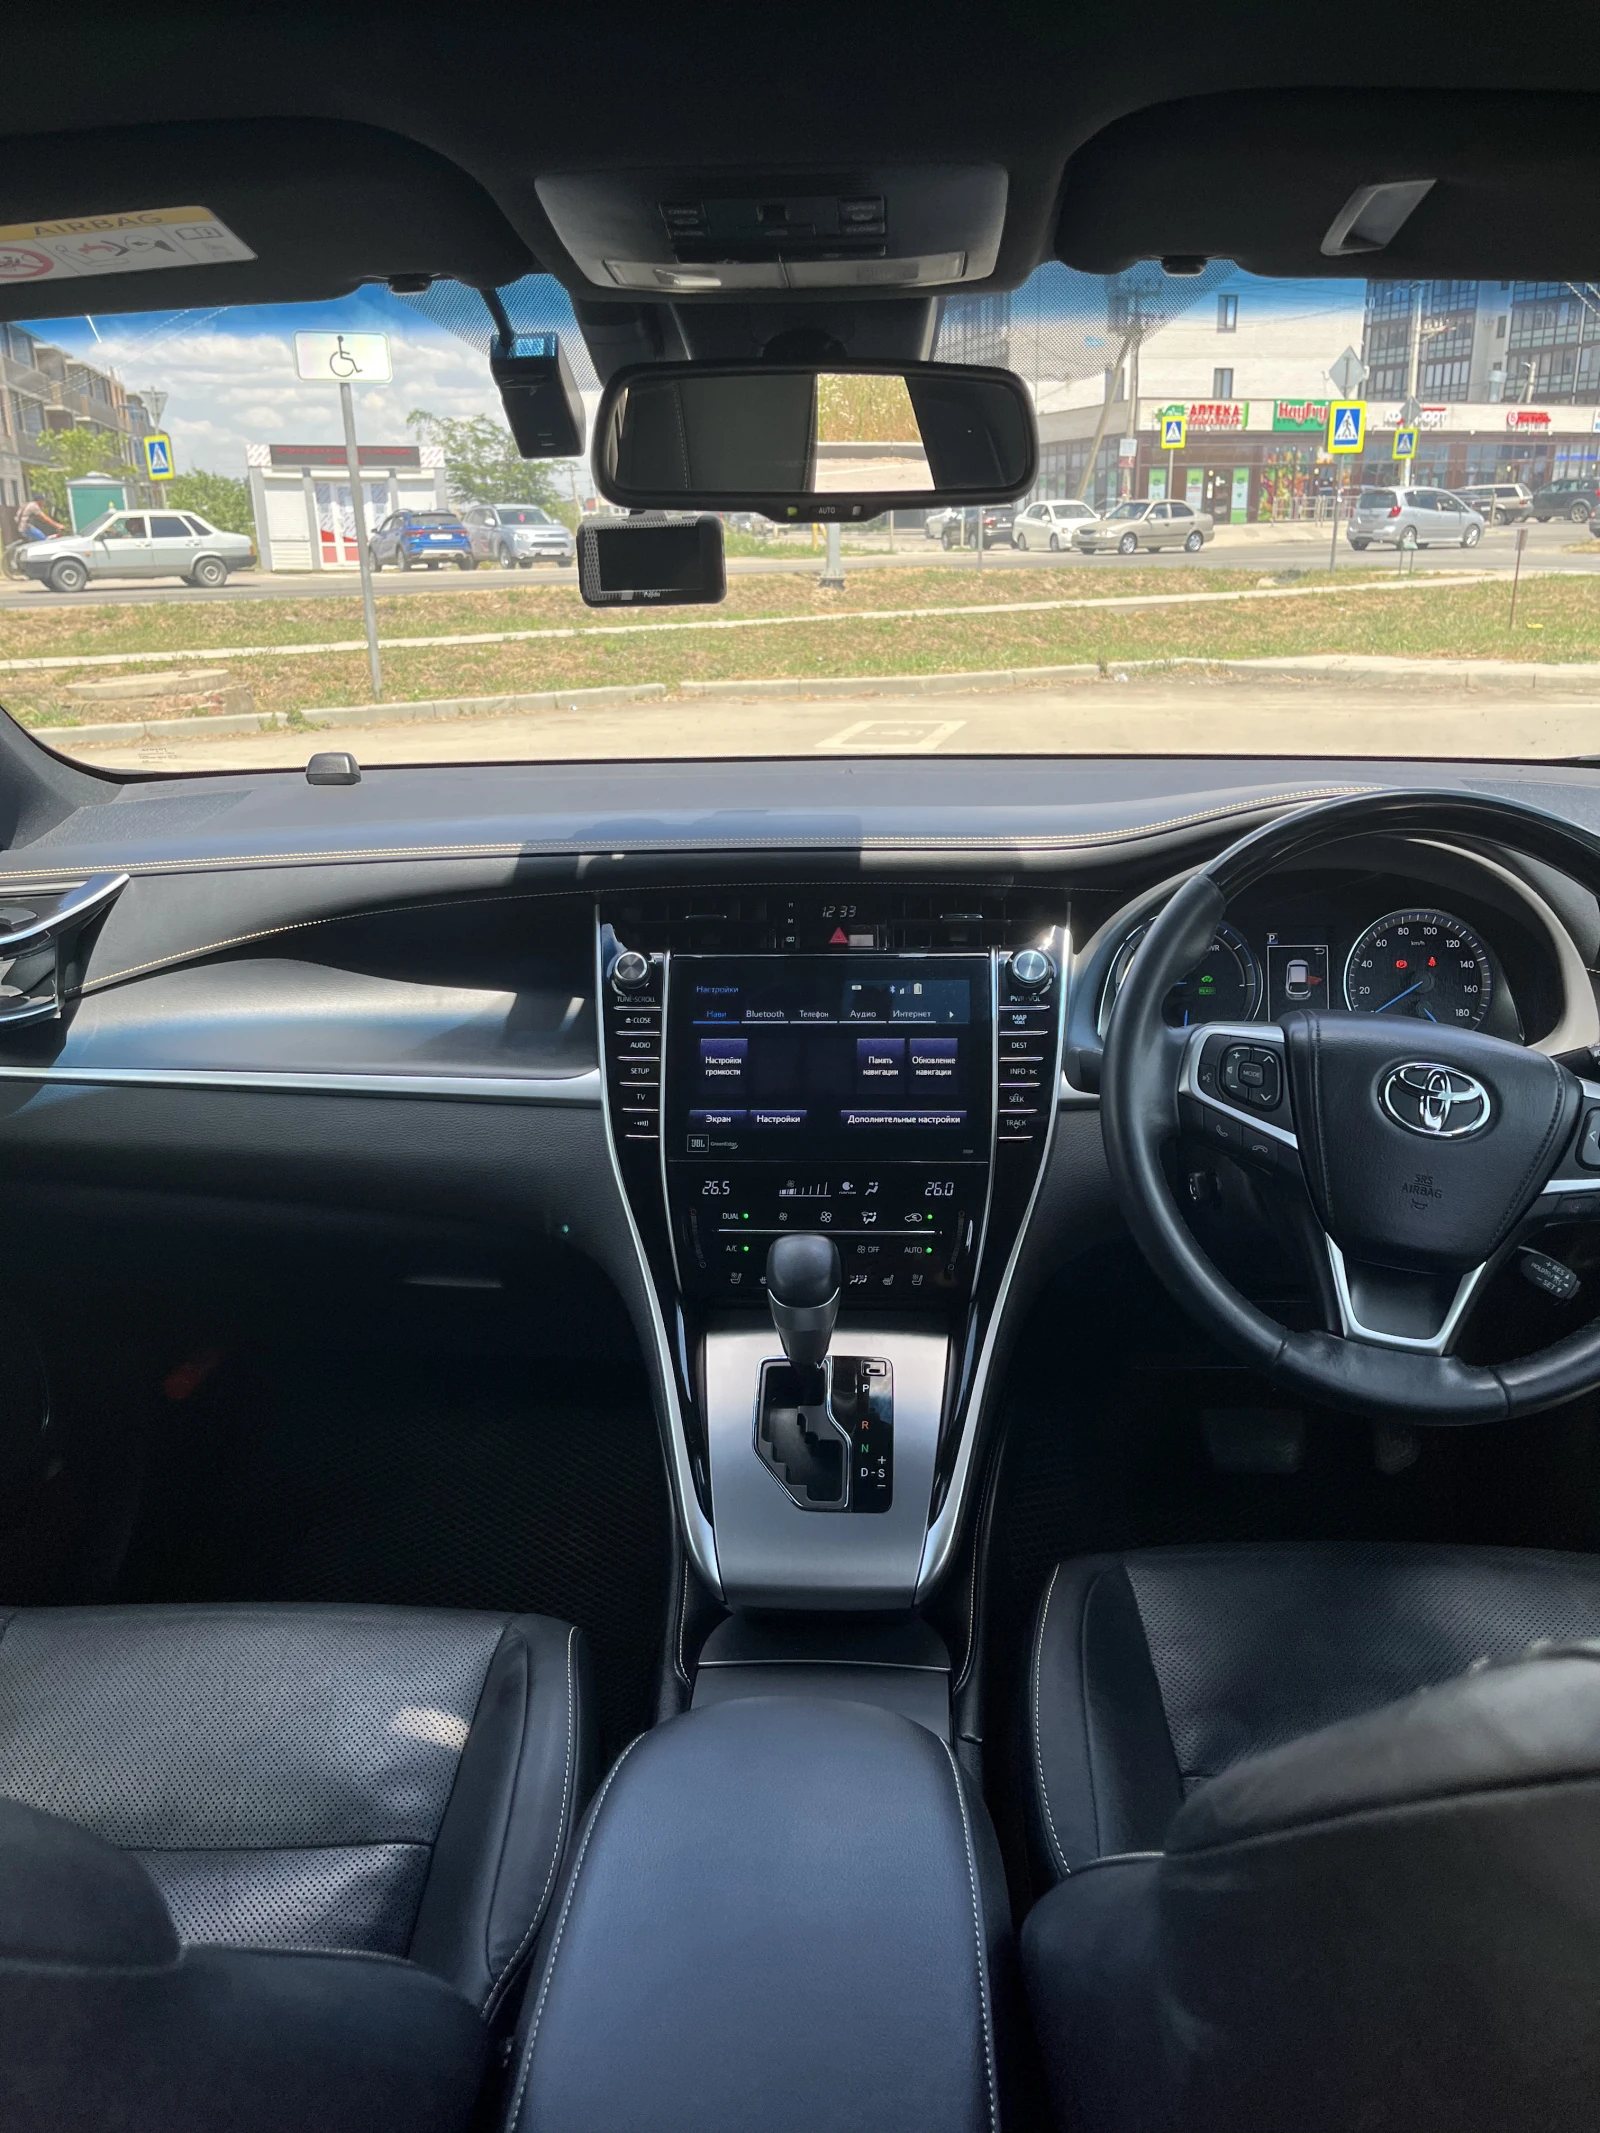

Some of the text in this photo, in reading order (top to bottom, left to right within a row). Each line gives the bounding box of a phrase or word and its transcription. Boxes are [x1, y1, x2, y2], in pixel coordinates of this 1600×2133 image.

[34, 213, 164, 235] AIRBAG
[1189, 403, 1241, 417] АПТЕКА
[818, 506, 836, 514] AUTO
[1397, 927, 1410, 935] 80
[1423, 927, 1438, 935] 100
[1268, 934, 1276, 943] P
[1375, 939, 1388, 947] 60
[1445, 939, 1460, 948] 120
[1361, 960, 1373, 968] 40
[1459, 960, 1475, 969] 140
[696, 985, 739, 995] Настройки
[1359, 986, 1371, 995] 20
[1463, 984, 1478, 993] 160
[706, 1010, 727, 1018] Нави
[746, 1009, 785, 1018] Bluetooth
[799, 1010, 829, 1020] Телефон
[850, 1010, 877, 1020] Аудио
[892, 1010, 932, 1020] Интернет
[1455, 1008, 1470, 1017] 180
[630, 1041, 651, 1049] AUDIO
[1011, 1041, 1027, 1049] DEST
[705, 1055, 742, 1066] Настройки
[868, 1056, 893, 1065] Память
[911, 1056, 956, 1065] Обновление
[630, 1067, 650, 1075] SETUP
[705, 1067, 741, 1077] громкости
[862, 1068, 899, 1077] навигации
[915, 1068, 952, 1077] навигации
[1242, 1070, 1261, 1078] MODE
[1009, 1095, 1025, 1103] SEEK
[705, 1114, 732, 1125] Экран
[756, 1113, 801, 1125] Настройки
[847, 1114, 961, 1125] Дополнительные настройки
[1005, 1119, 1027, 1127] TRACK
[691, 1138, 706, 1148] JBL
[1414, 1173, 1434, 1186] SRS
[701, 1180, 731, 1195] 26.5
[924, 1181, 955, 1196] 26.0
[1401, 1182, 1443, 1199] AIRBAG
[722, 1212, 739, 1220] DUAL
[725, 1244, 738, 1252] A/C
[904, 1246, 923, 1254] AUTO
[1552, 1264, 1566, 1276] RES
[1542, 1280, 1557, 1290] SET
[862, 1384, 869, 1392] P
[861, 1420, 869, 1429] R
[861, 1444, 869, 1453] N
